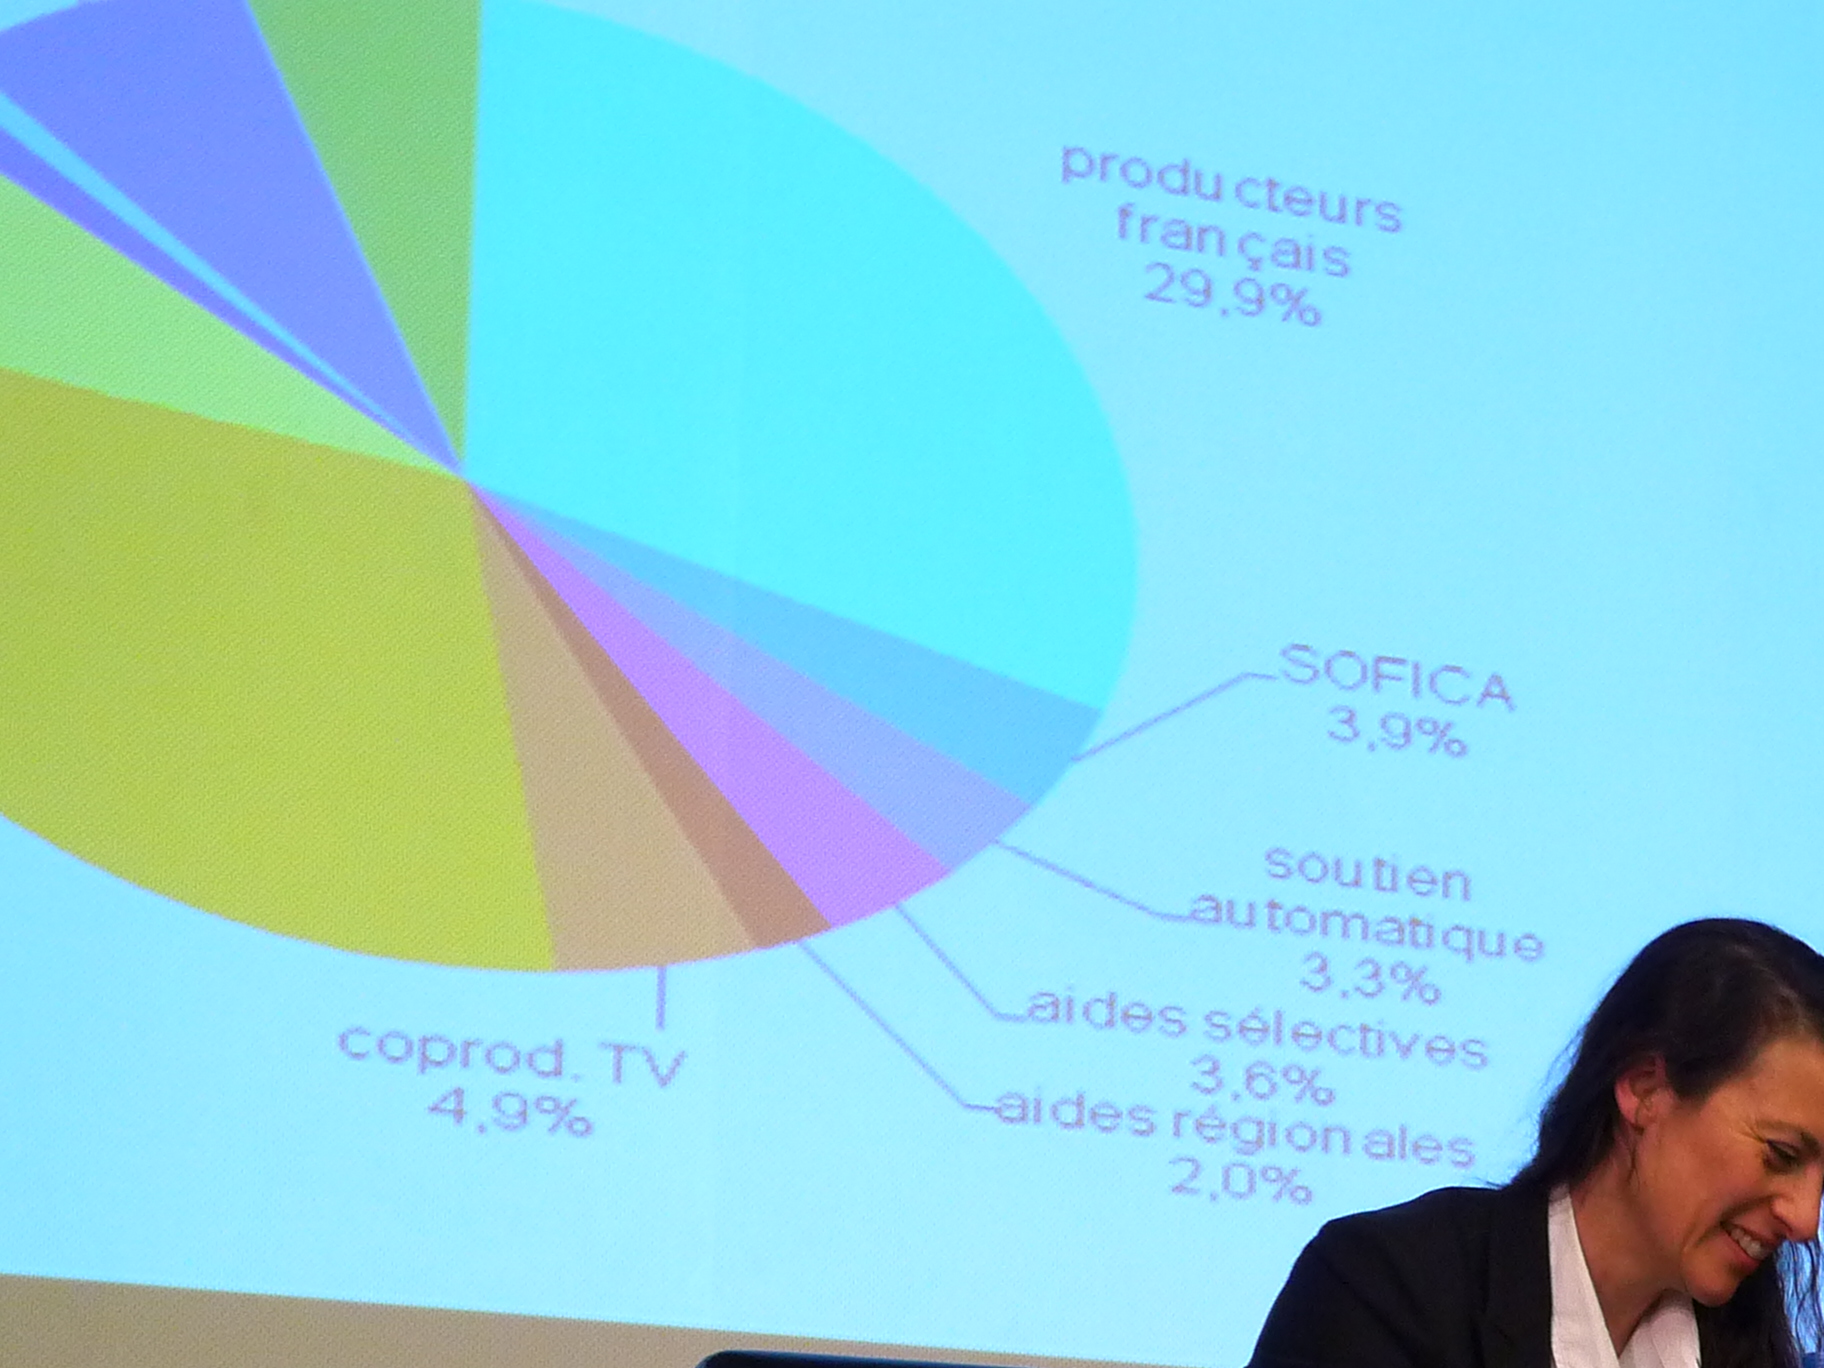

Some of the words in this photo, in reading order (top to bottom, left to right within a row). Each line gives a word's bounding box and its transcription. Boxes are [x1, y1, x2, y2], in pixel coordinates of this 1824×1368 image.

[1062, 146, 1403, 233] producteurs
[1117, 203, 1351, 278] français
[1280, 643, 1515, 712] SOFICA
[1265, 847, 1471, 902] soutien
[1190, 894, 1545, 963] automatique
[338, 1026, 582, 1081] coprod.
[599, 1042, 687, 1088] TV
[1027, 988, 1187, 1038] aides
[1204, 1007, 1488, 1069] sélectives
[995, 1088, 1157, 1137] aides
[1173, 1105, 1476, 1170] régionales
